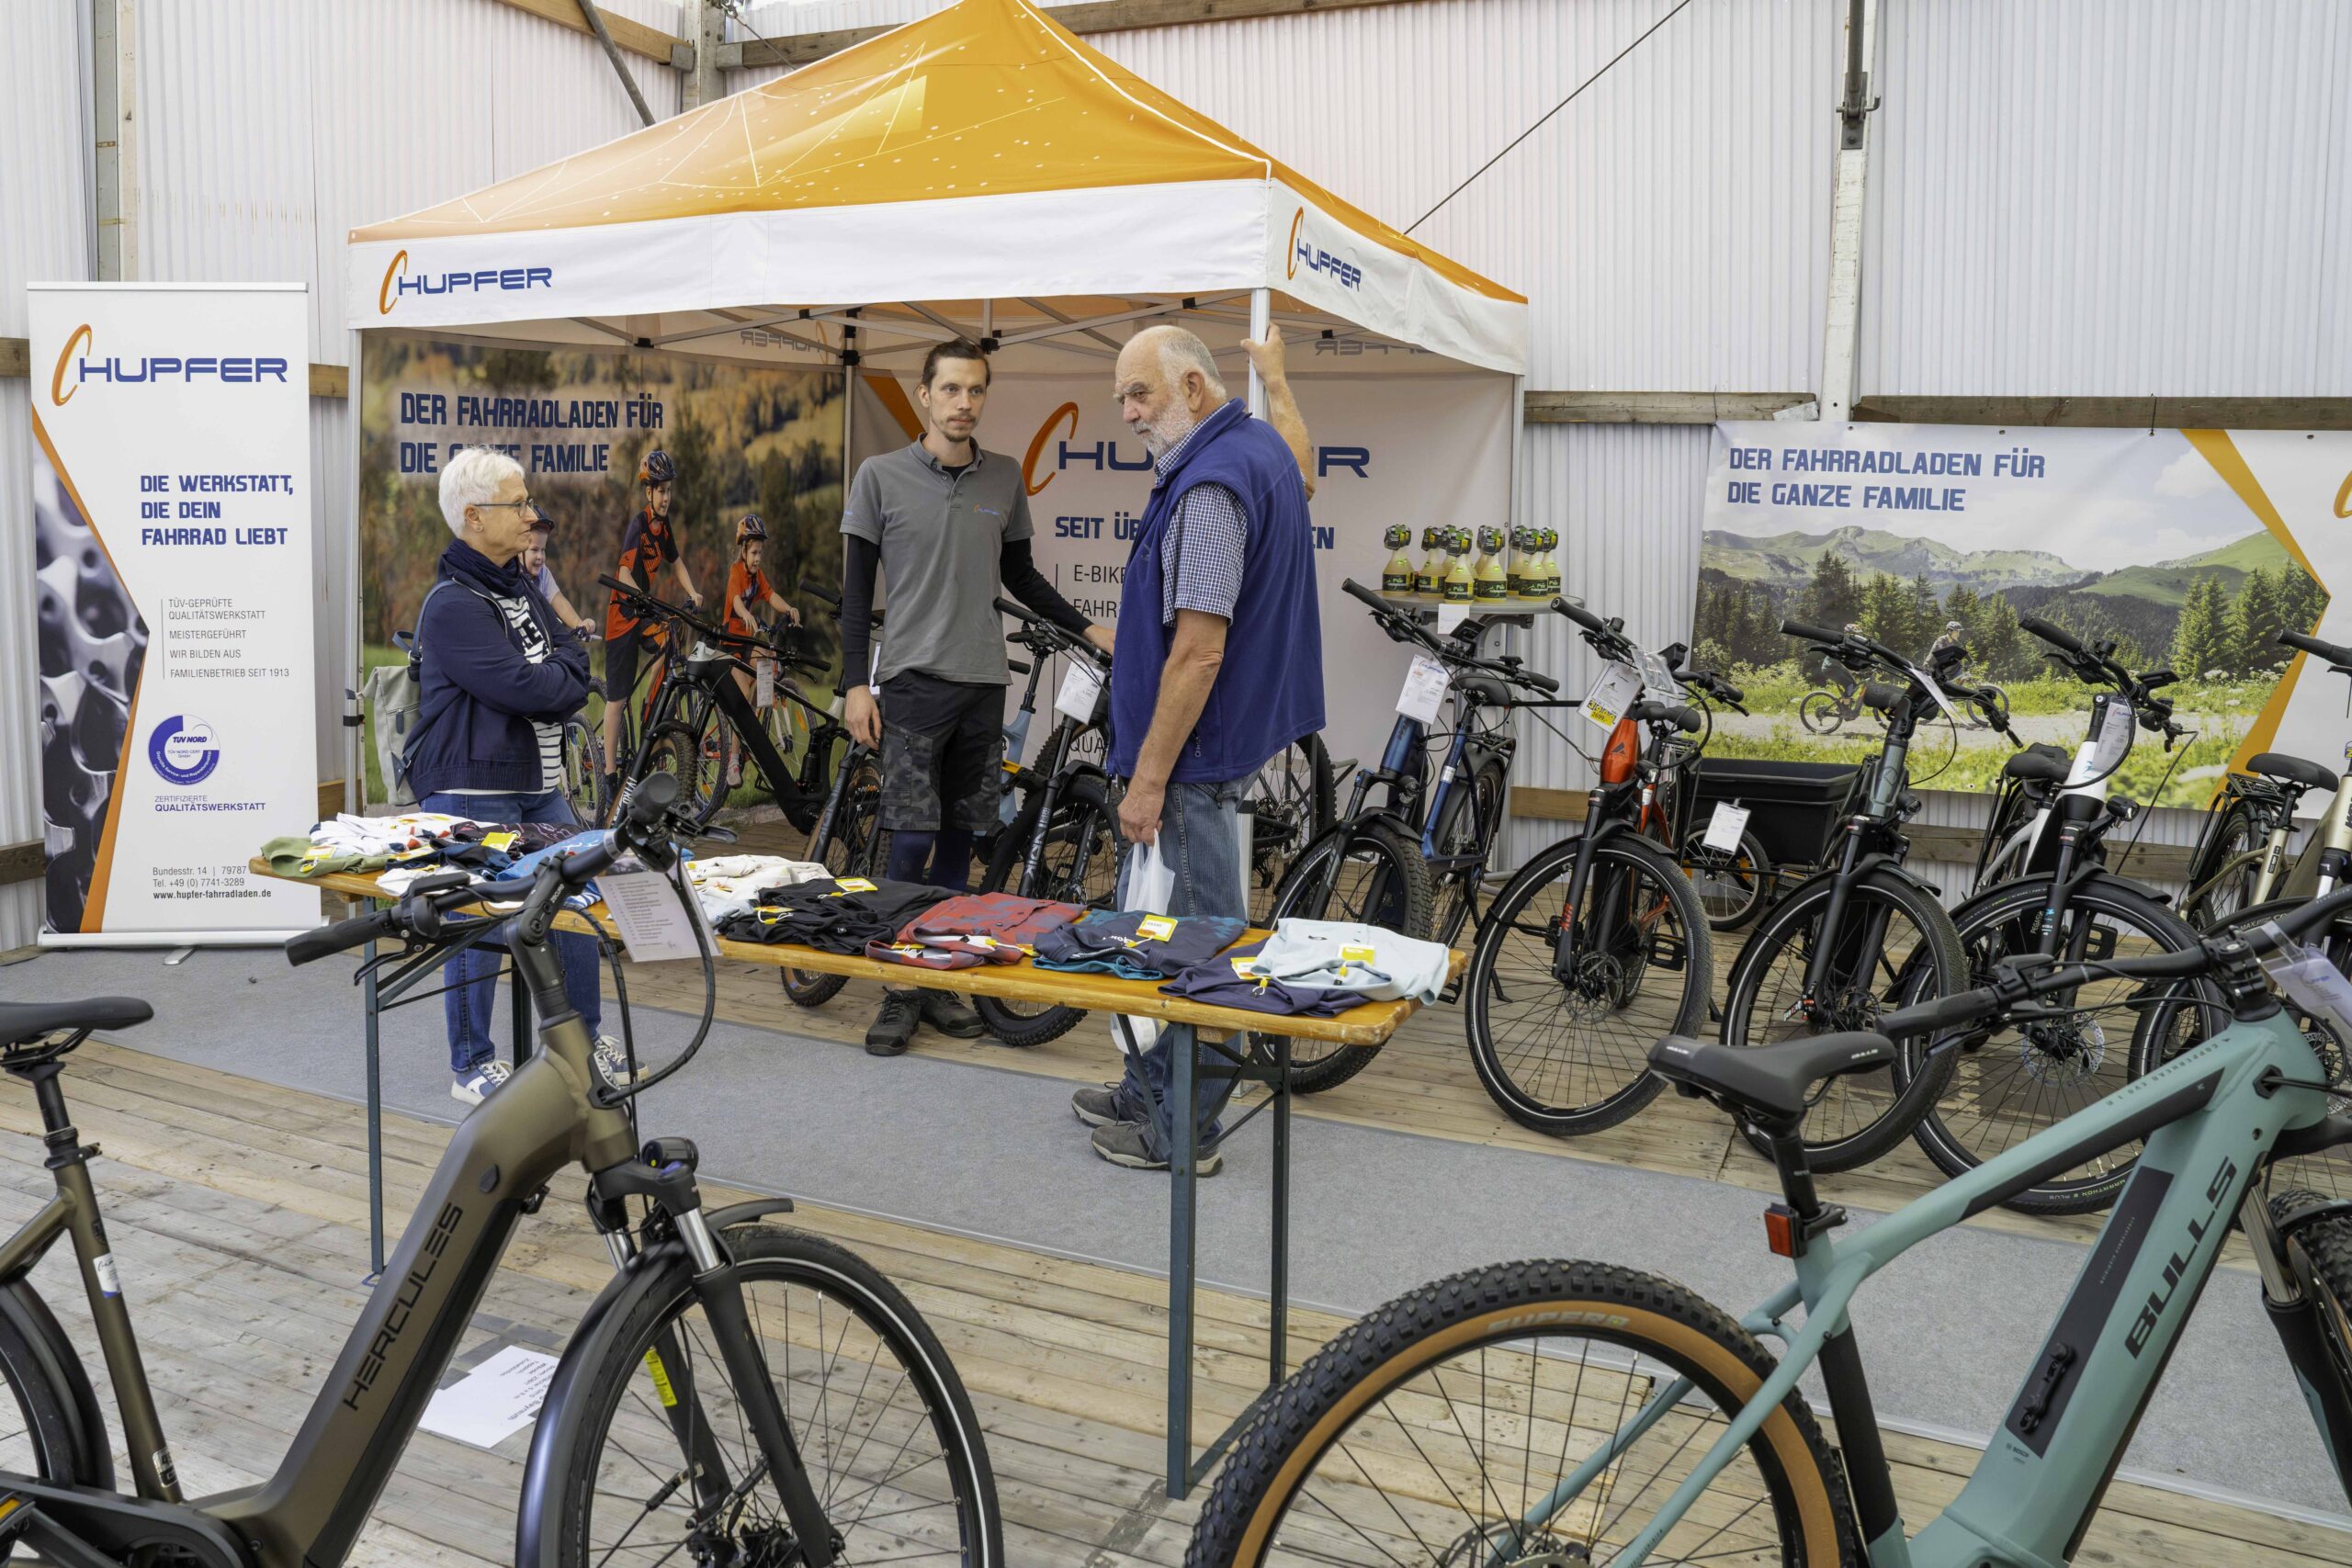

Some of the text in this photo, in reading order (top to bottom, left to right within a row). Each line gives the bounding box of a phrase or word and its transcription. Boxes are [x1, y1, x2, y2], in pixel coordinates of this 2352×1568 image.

[1296, 245, 1362, 292] HUPFER
[398, 266, 553, 296] HUPFER
[79, 357, 288, 383] HUPFER
[401, 392, 663, 429] DER FAHRRADLADEN FÜR
[400, 442, 437, 473] DIE
[531, 444, 610, 473] FAMILIE
[1729, 446, 2046, 479] DER FAHRRADLADEN FÜR
[141, 475, 294, 495] DIE WERKSTATT,
[1727, 481, 1966, 512] DIE GANZE FAMILIE
[141, 502, 221, 519] DIE DEIN
[141, 527, 288, 546] FAHRRAD LIEBT
[1055, 516, 1104, 539] SEIT
[168, 598, 233, 609] TÜV-GEPRÜFTE
[168, 609, 266, 621] QUALITÄTSWERKSTATT
[169, 629, 247, 640] MEISTERGEFÜHRT
[170, 649, 242, 659] WIR BILDEN AUS
[170, 668, 289, 678] FAMILIENBETRIEB SEIT 1913
[154, 795, 208, 803] ZERTIFIZIERTE
[154, 802, 266, 812] QUALITÄTSWERKSTATT
[153, 865, 247, 875] Bundesstr. 14 79787
[153, 878, 245, 890] Tel. +49 (0) 7741-3289
[153, 888, 272, 899] www.hupfer-fahrradladen.de
[2124, 1156, 2238, 1359] BULLS
[343, 1201, 464, 1411] HERCULES
